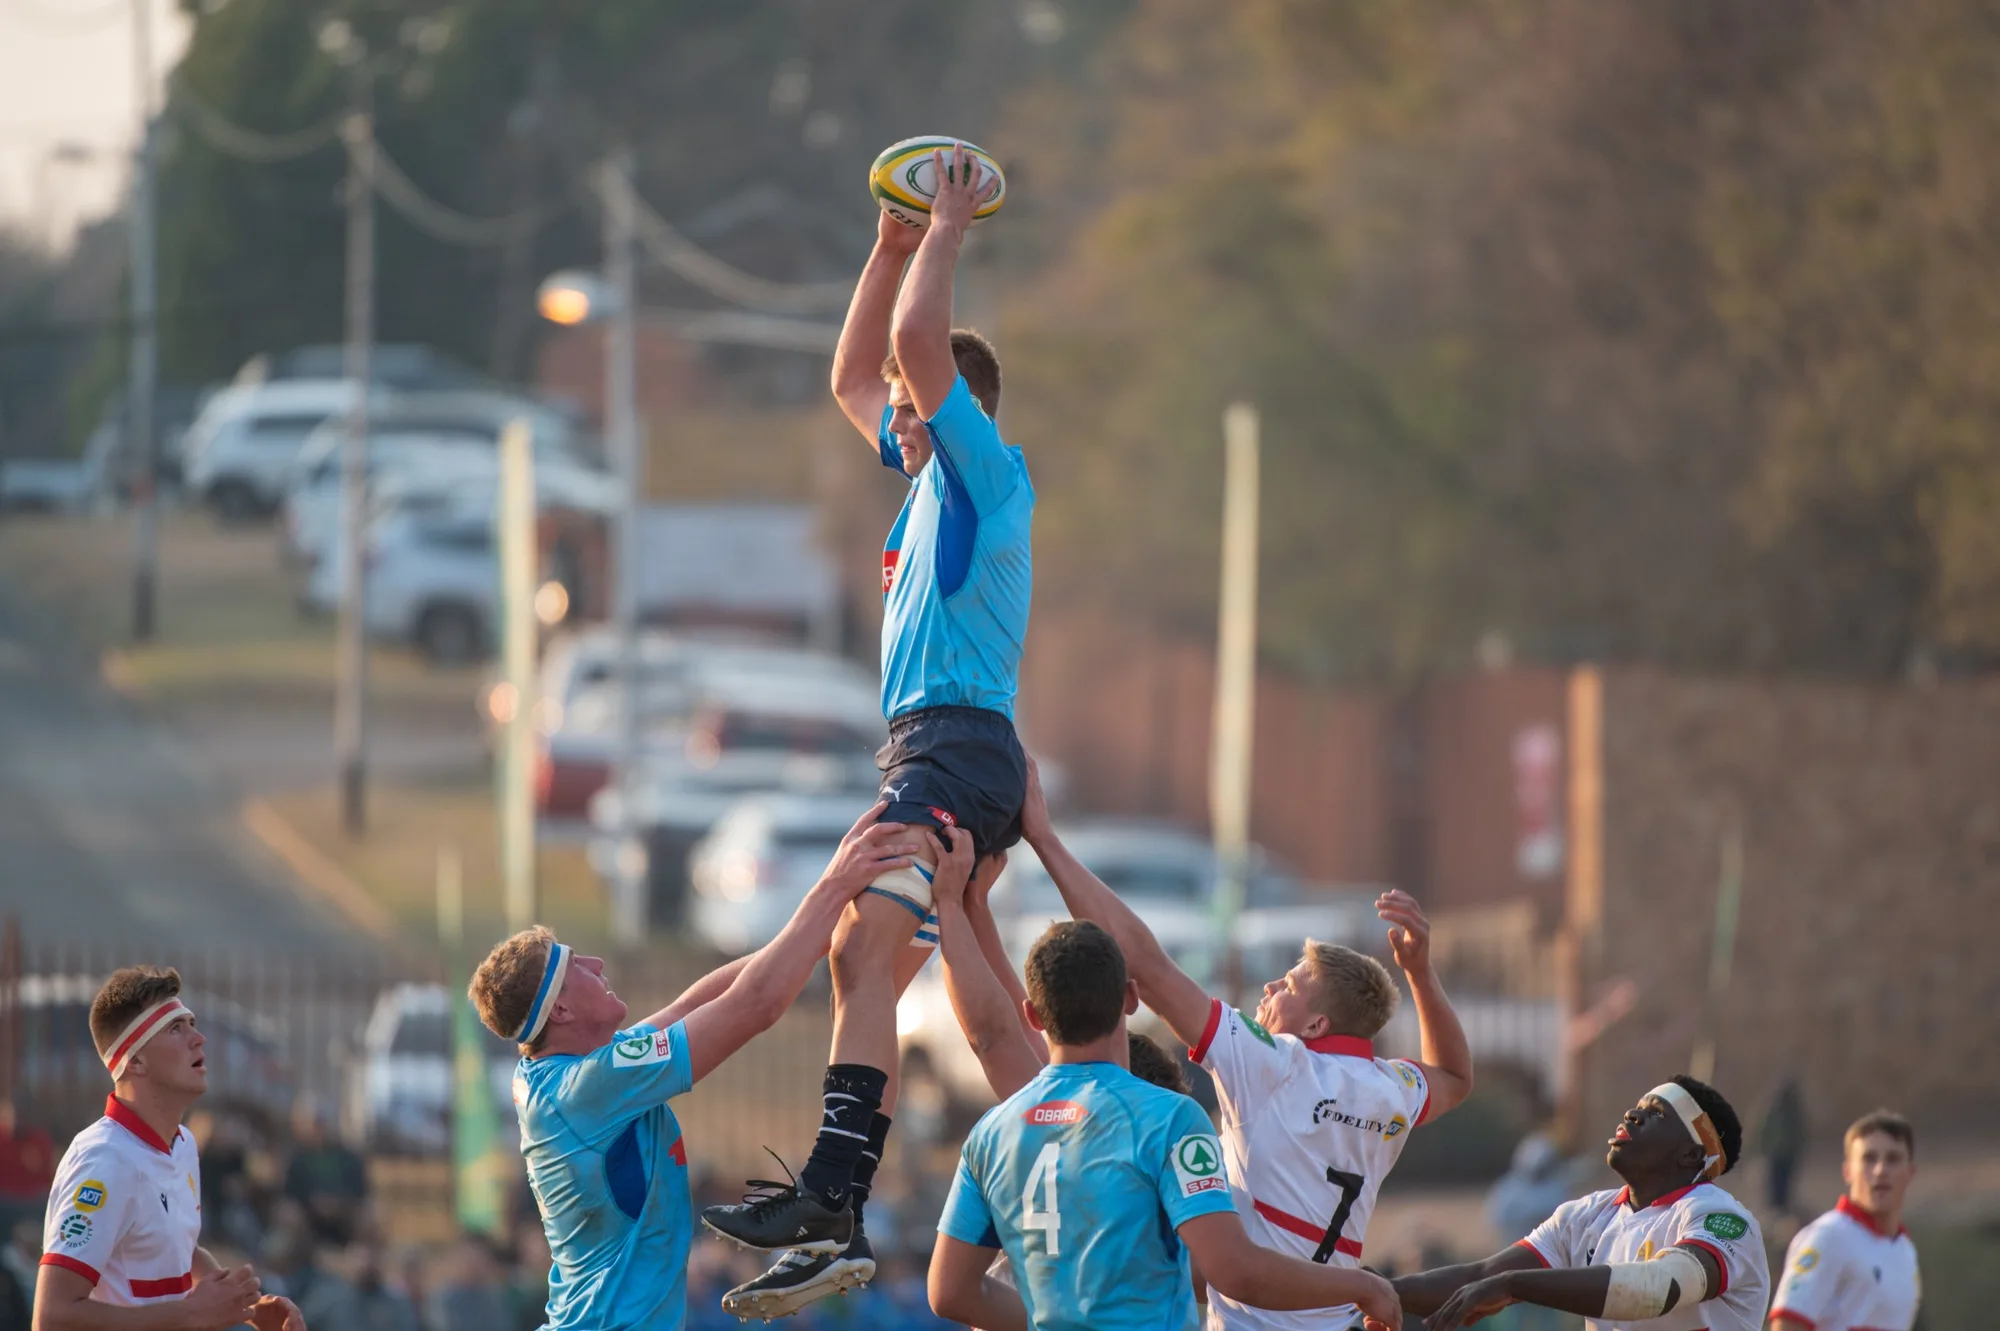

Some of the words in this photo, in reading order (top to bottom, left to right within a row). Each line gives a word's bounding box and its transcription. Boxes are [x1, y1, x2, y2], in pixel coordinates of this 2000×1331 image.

[1034, 1108, 1077, 1122] OBARO
[78, 1189, 103, 1205] ADT
[1022, 1142, 1062, 1256] 4
[1312, 1166, 1365, 1265] 7
[1720, 1239, 1736, 1257] PITAL
